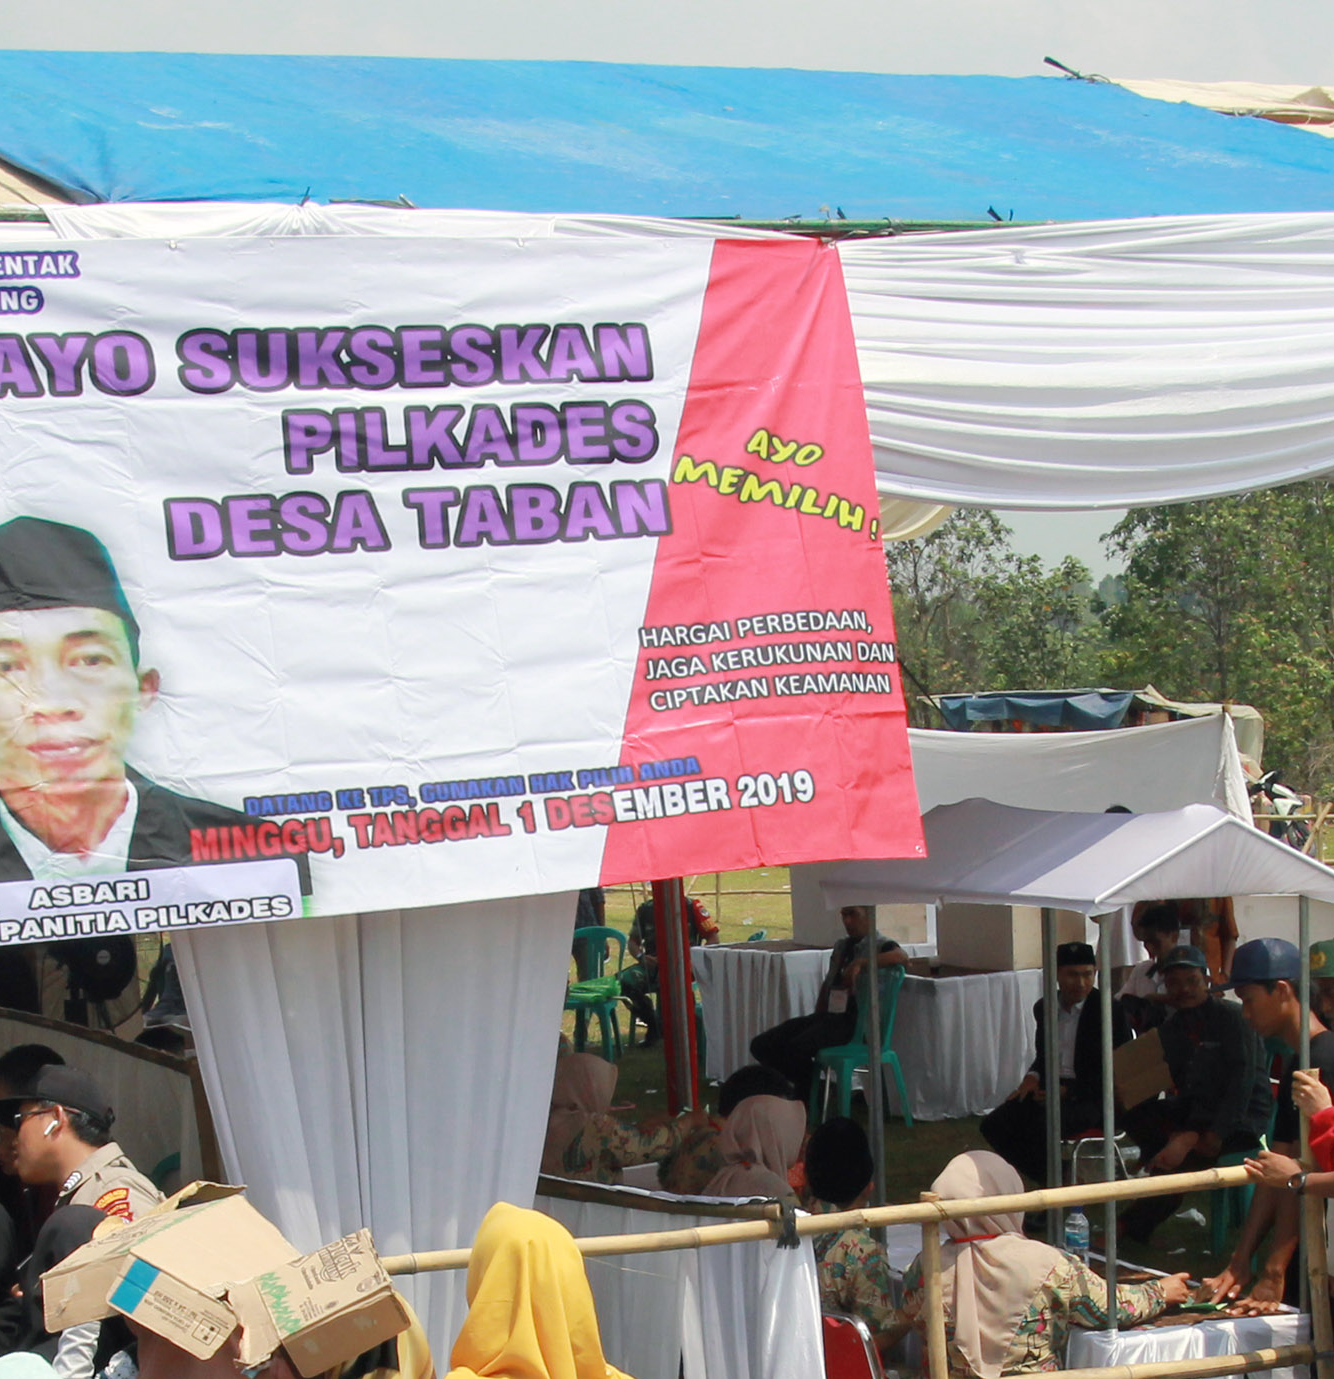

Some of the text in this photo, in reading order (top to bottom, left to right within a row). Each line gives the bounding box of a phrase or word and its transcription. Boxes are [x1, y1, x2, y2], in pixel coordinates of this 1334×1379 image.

[178, 323, 653, 393] SUKSESKAN
[282, 400, 660, 475] PILKADES
[746, 428, 824, 466] AYO
[163, 479, 672, 560] DESA TABAN
[639, 610, 873, 648] HARGAI PERBEDAAN,
[645, 641, 895, 681] JAGA KERUKUNAN DAN
[649, 673, 891, 712] CIPTAKAN KEAMANAN
[243, 756, 702, 817] DATANG KE TPS, GUNAKAN HAK PILIH ANDA
[189, 769, 815, 862] MINGGU, TANGGAL 1 DESEMBER 2019
[29, 879, 150, 910] ASBARI
[136, 896, 294, 930] PILKADES
